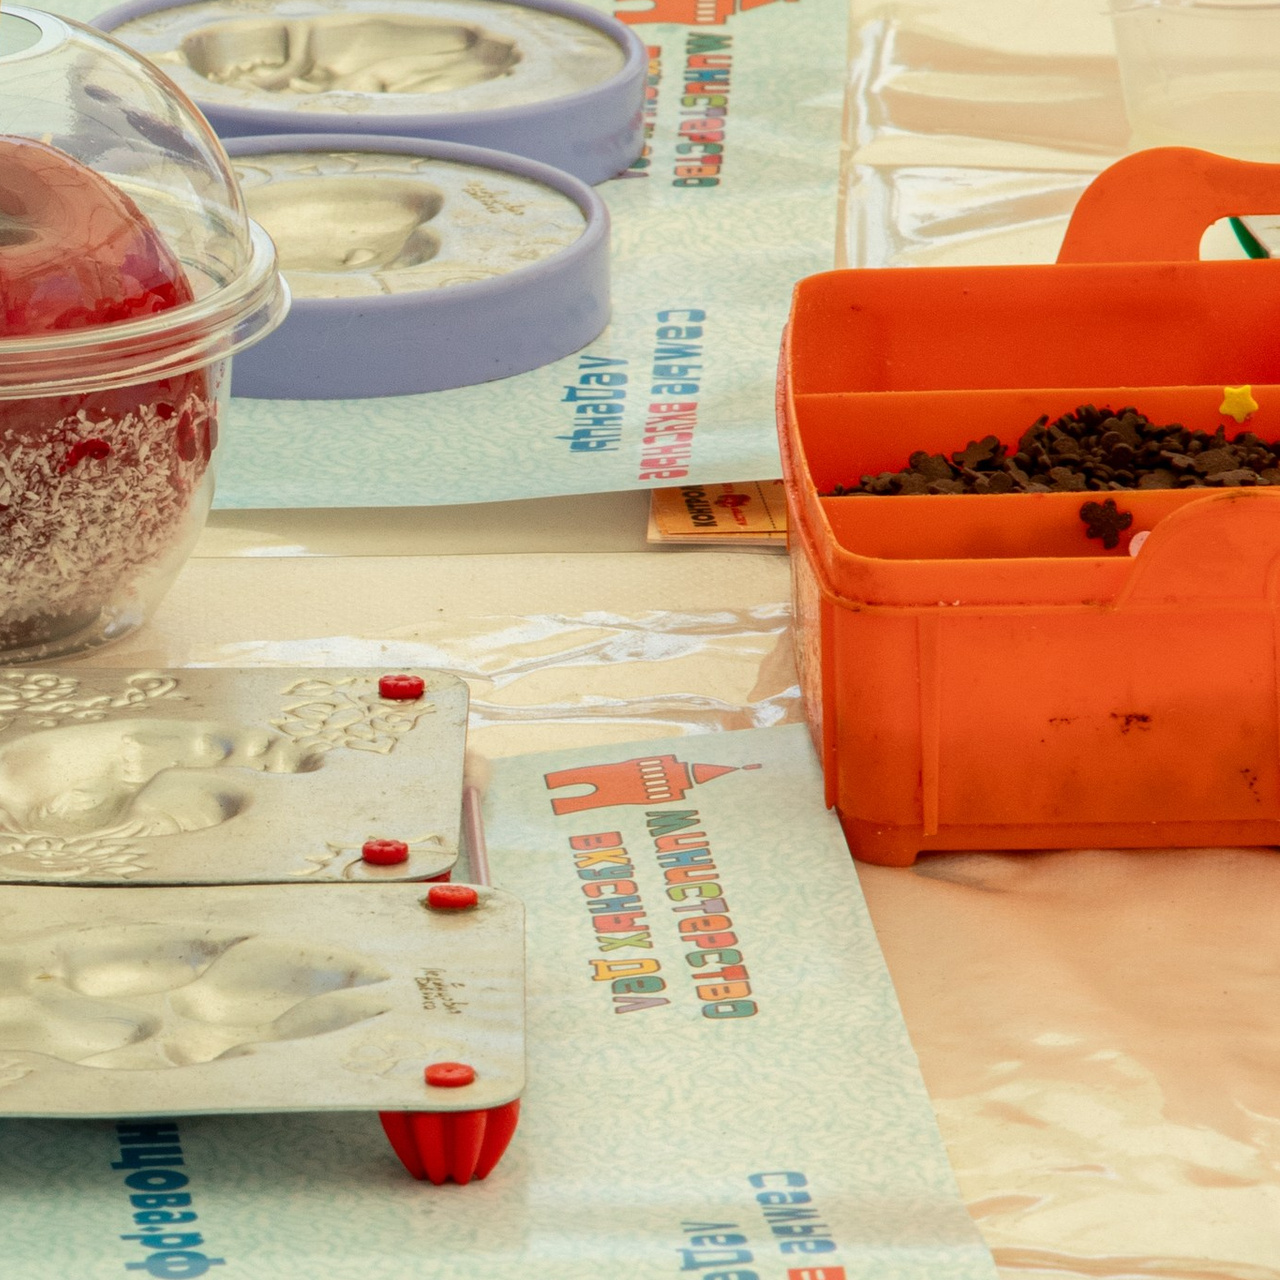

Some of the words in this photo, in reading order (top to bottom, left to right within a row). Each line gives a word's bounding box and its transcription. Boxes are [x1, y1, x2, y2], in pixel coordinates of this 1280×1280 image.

[556, 355, 629, 453] леденцы
[637, 401, 699, 481] вкусные
[569, 830, 655, 952] вкусных
